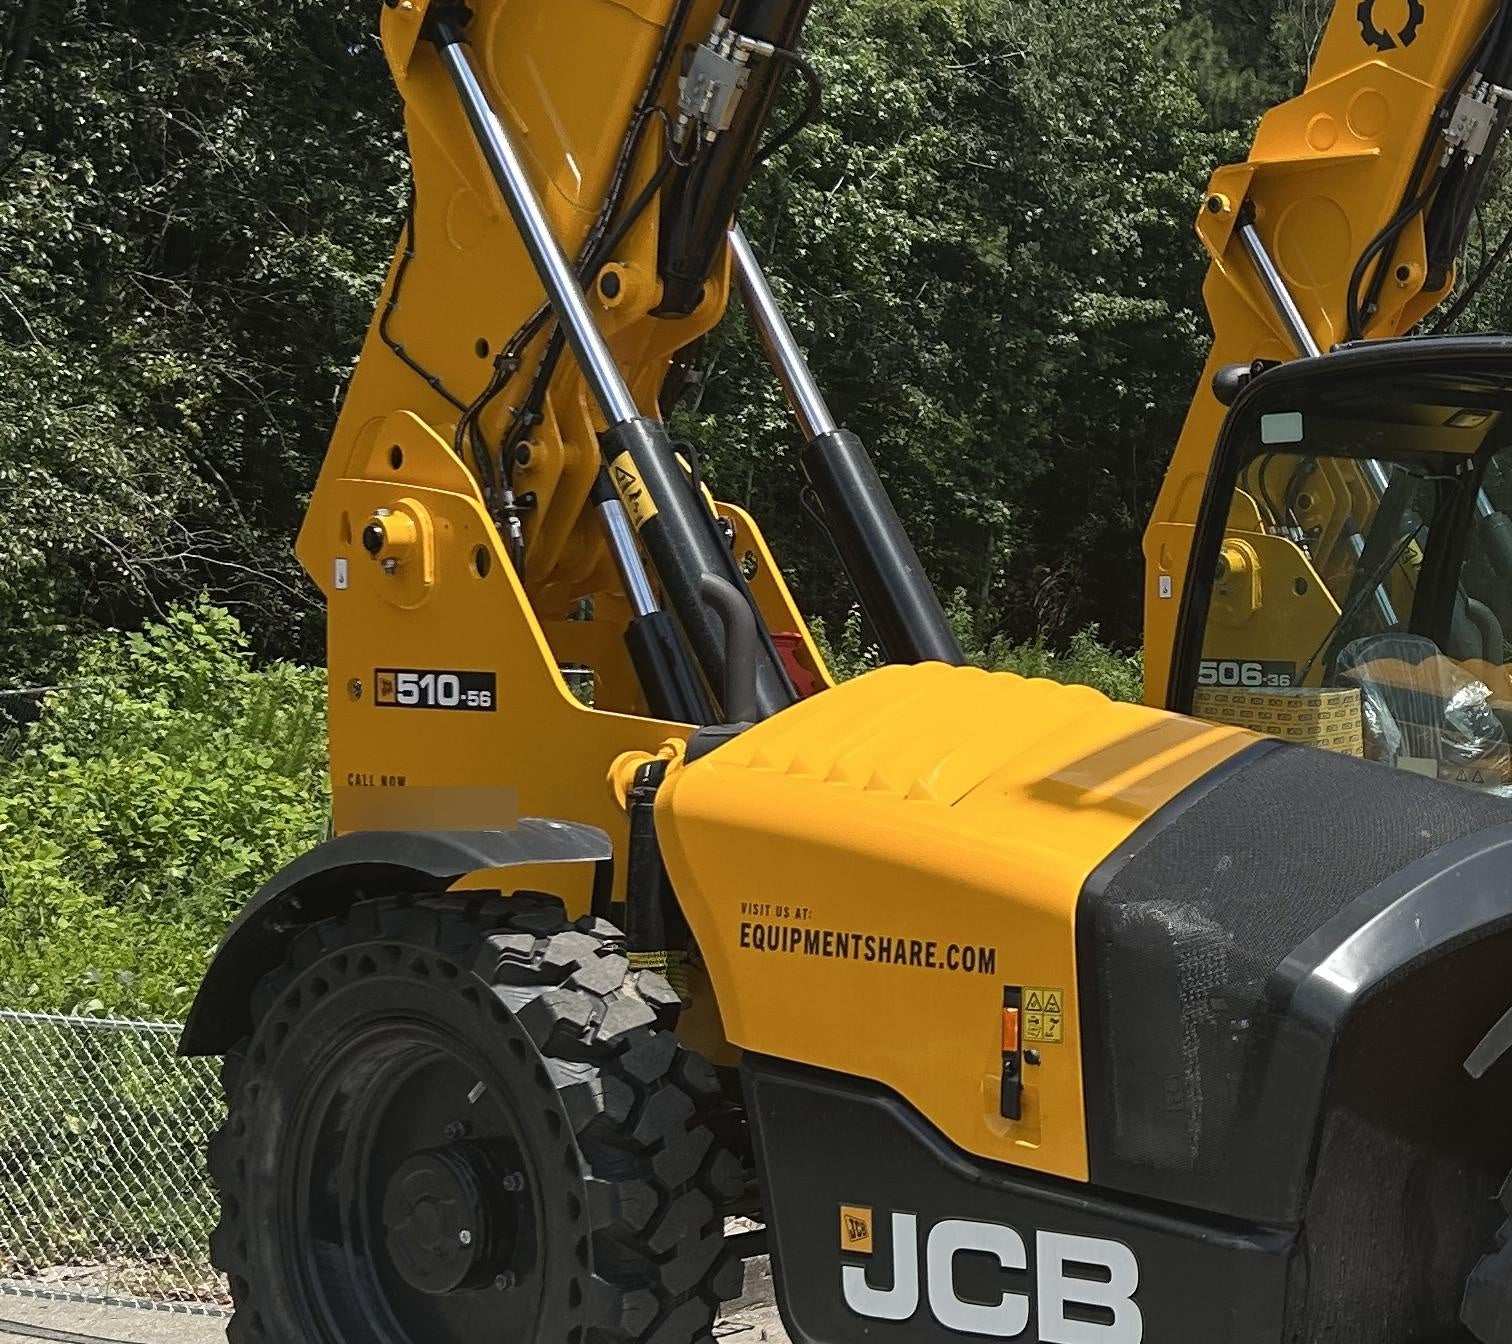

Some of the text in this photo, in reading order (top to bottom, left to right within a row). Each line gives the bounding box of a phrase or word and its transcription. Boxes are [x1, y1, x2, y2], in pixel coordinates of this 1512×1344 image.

[396, 673, 492, 706] 510-56
[347, 773, 406, 786] CALL NOW
[740, 902, 813, 921] VISIT US AT:
[739, 922, 997, 975] EQUIPMENTSHARE.COM
